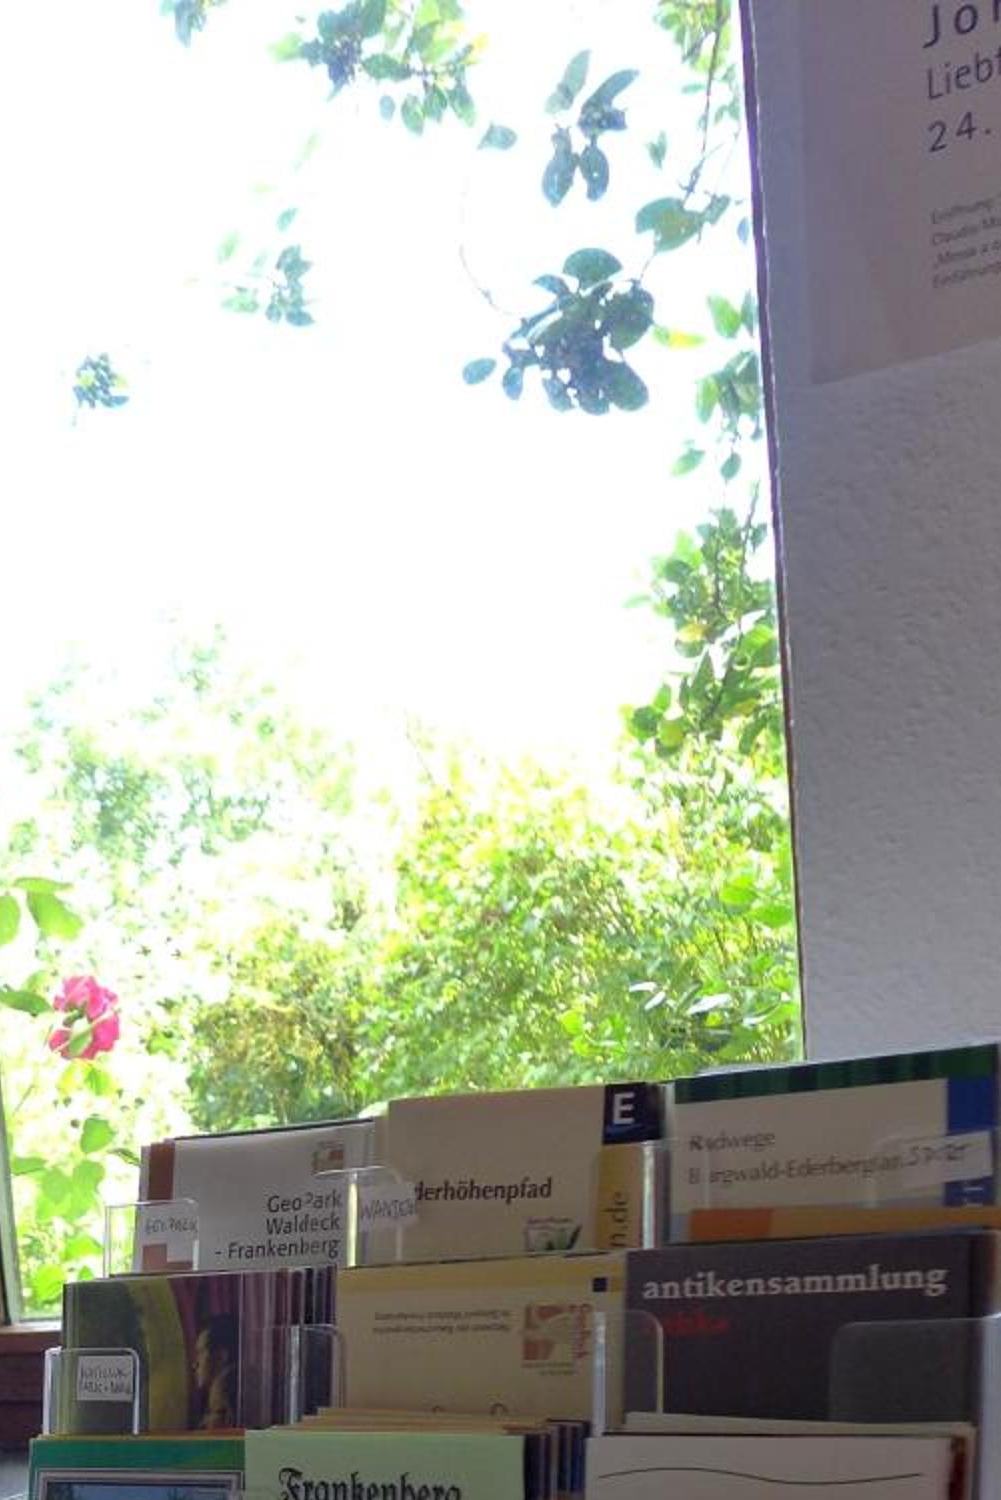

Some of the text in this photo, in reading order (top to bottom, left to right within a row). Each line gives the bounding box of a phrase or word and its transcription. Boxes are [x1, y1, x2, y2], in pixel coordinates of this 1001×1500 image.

[927, 111, 991, 152] 24.
[266, 1212, 340, 1236] Waldeck
[228, 1237, 340, 1259] Frankenberg
[643, 1263, 948, 1299] antikensammlung
